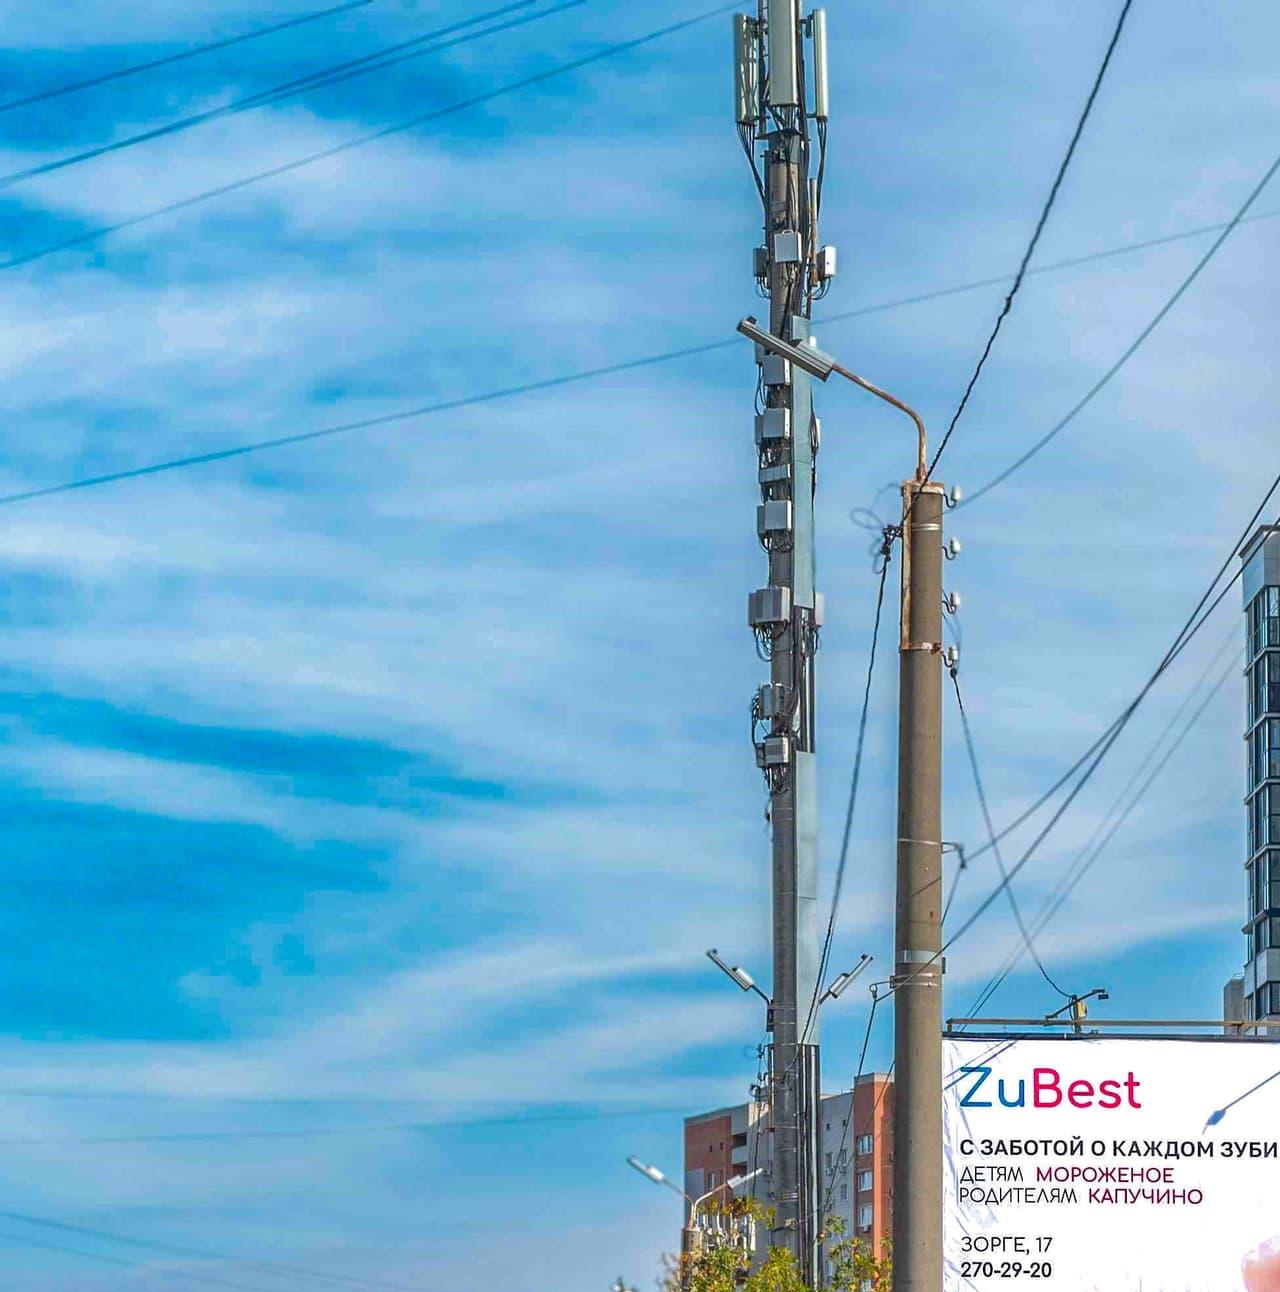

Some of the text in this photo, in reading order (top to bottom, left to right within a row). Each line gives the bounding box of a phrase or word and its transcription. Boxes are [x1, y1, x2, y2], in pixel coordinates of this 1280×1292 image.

[959, 1066, 1142, 1109] ZuBest
[960, 1139, 974, 1156] С
[980, 1135, 1084, 1156] ЗАБОТОЙ
[1091, 1140, 1106, 1156] О
[1113, 1140, 1214, 1160] КАЖДОМ
[960, 1166, 1175, 1184] ДЕТЯМ МОРОЖЕНОЕ
[959, 1187, 1204, 1206] РОДИТЕЛЯМ КАПУЧИНО
[961, 1236, 1053, 1255] ЗОРГЕ, 17
[960, 1261, 1053, 1278] 270-29-20
